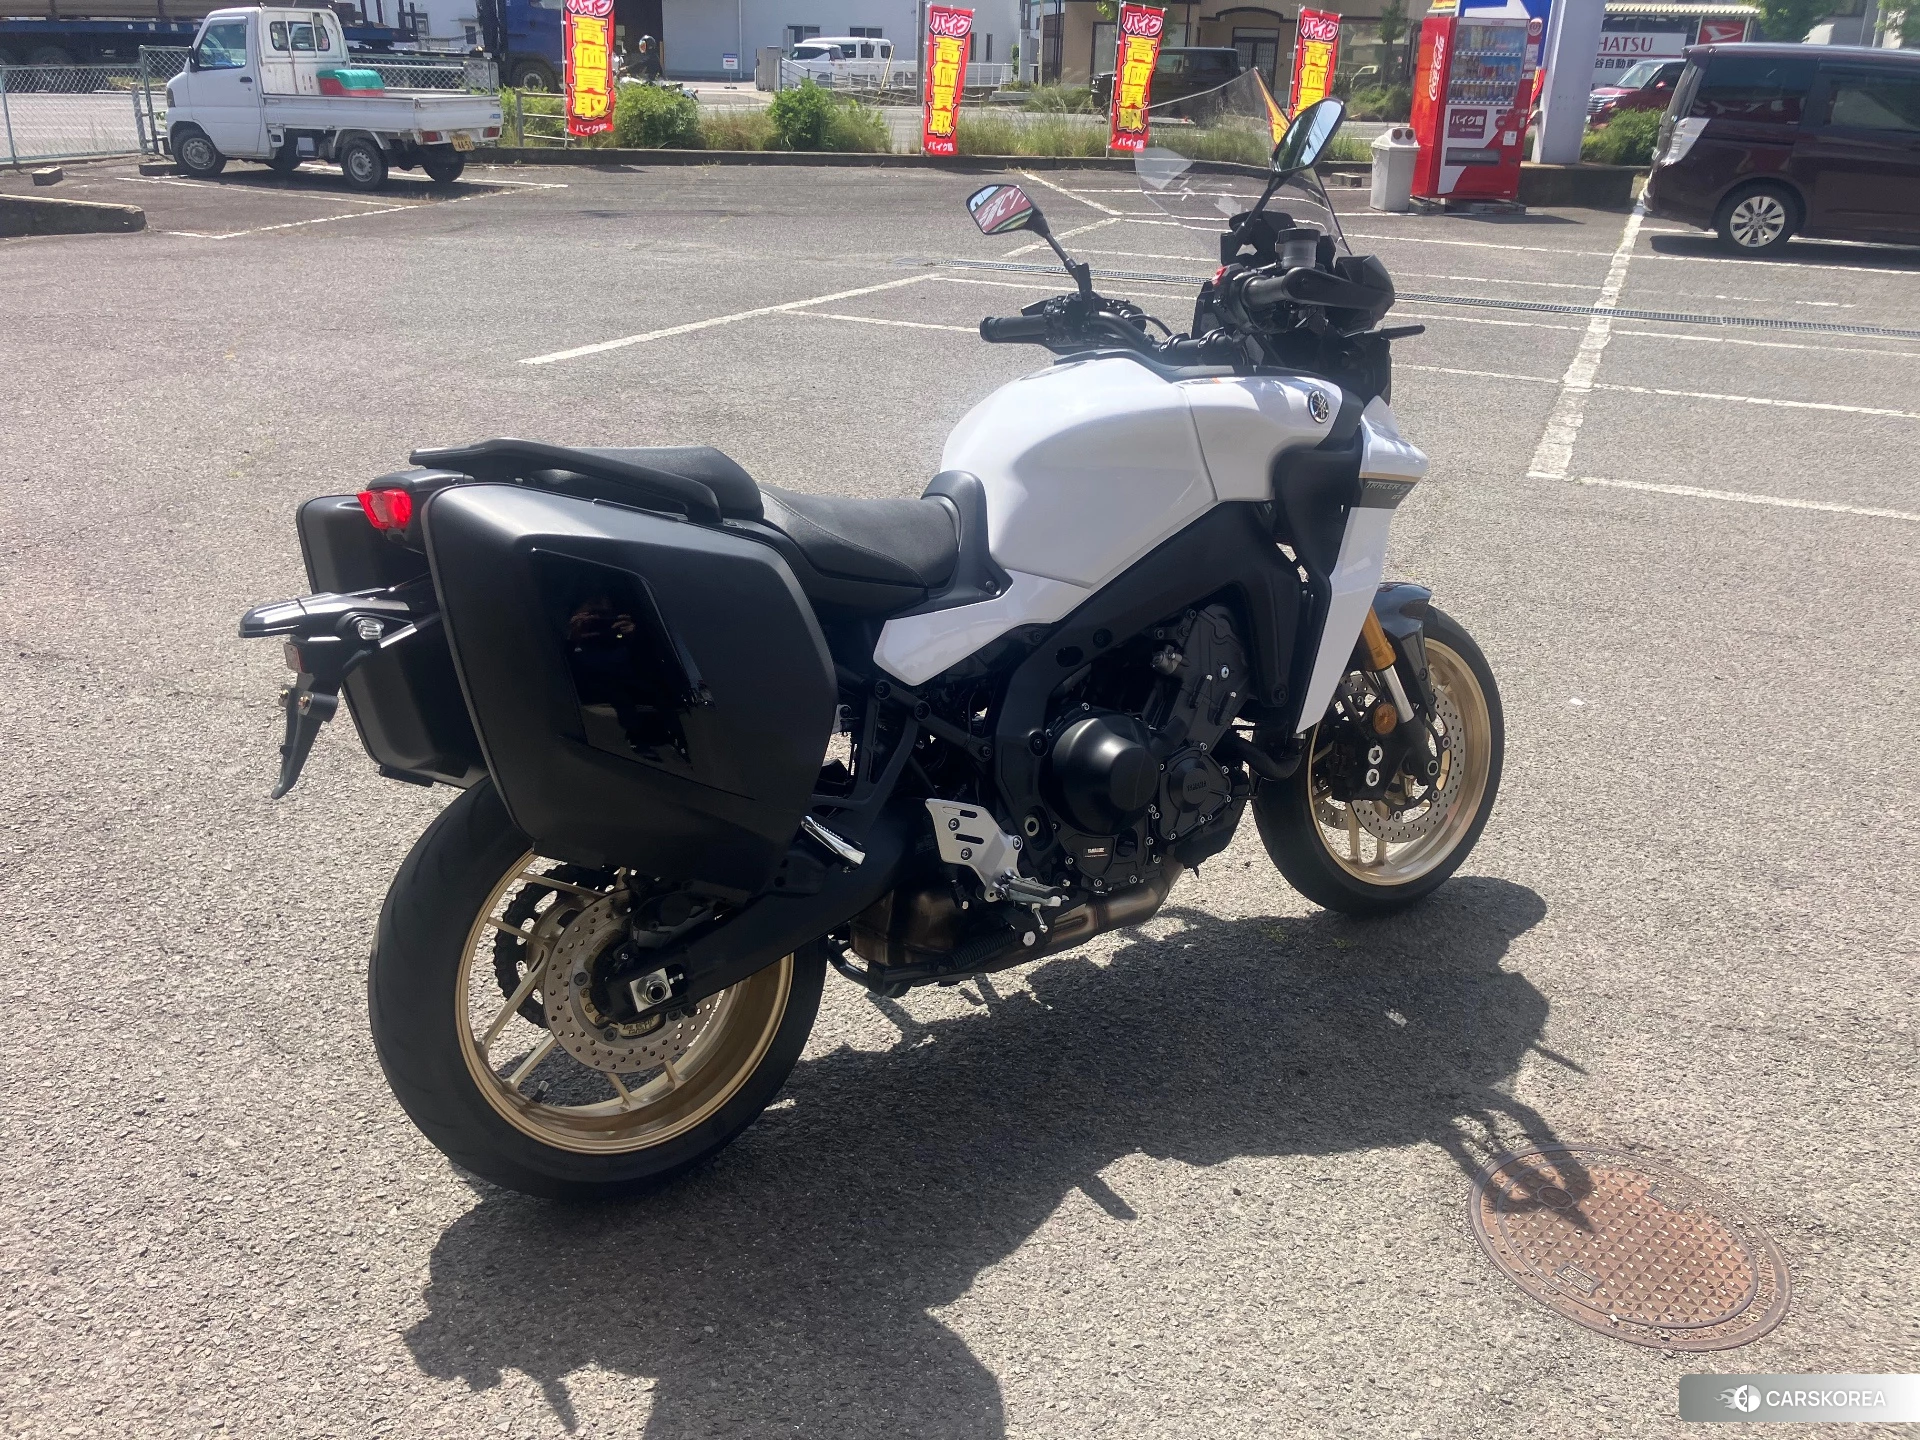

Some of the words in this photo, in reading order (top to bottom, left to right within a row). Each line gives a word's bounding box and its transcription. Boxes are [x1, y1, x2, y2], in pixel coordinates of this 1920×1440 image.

[933, 14, 970, 35] バイク
[1126, 14, 1162, 34] バイク
[1303, 19, 1338, 38] バイク
[573, 16, 609, 118] 高価買取
[930, 37, 963, 134] 高価買取
[1118, 36, 1157, 132] 高価買取
[1293, 41, 1333, 117] 高価買
[1365, 480, 1401, 490] TRACER
